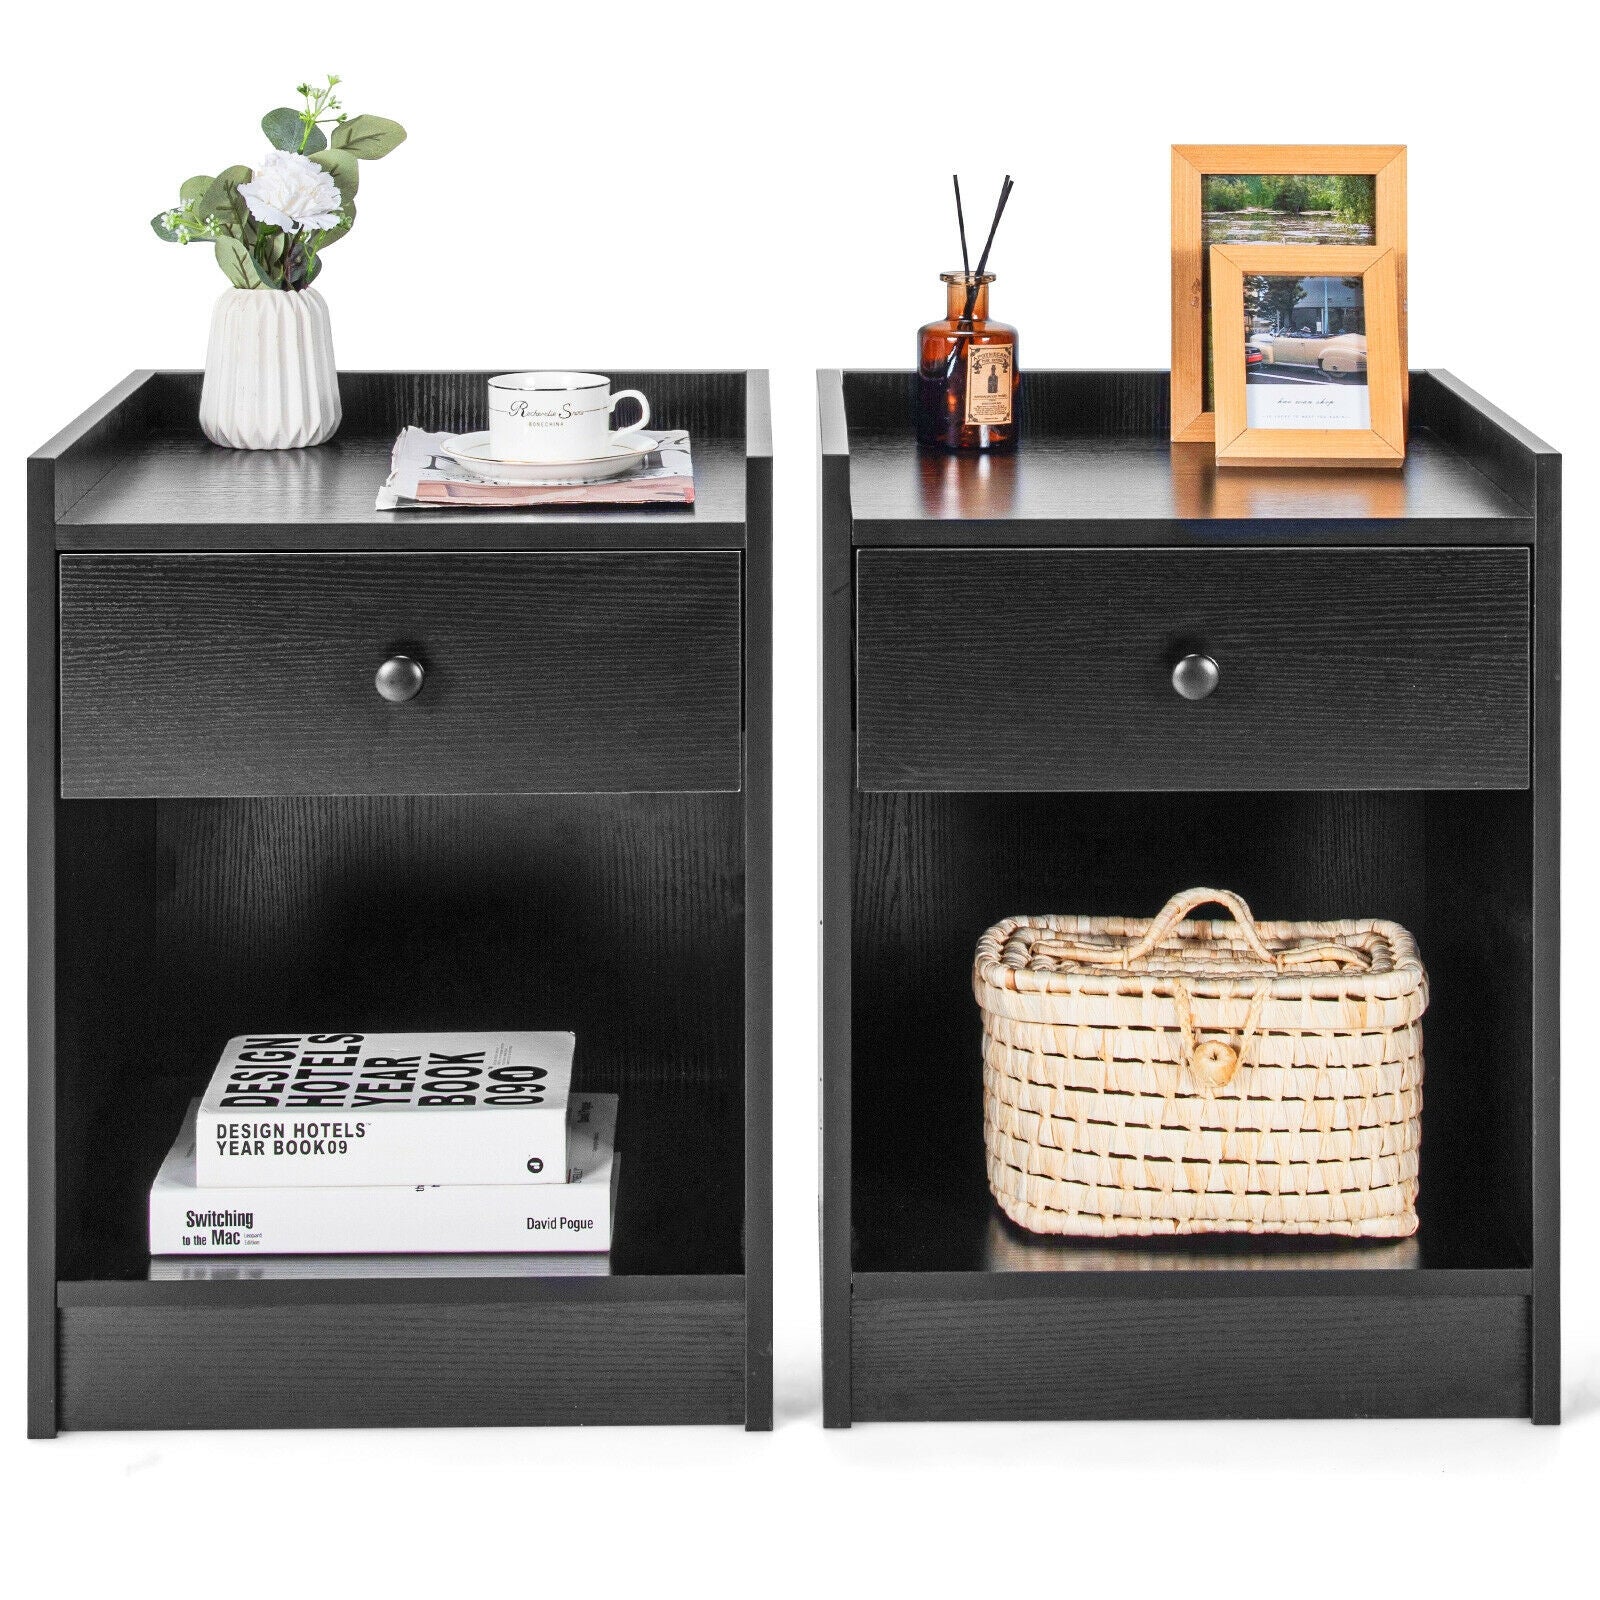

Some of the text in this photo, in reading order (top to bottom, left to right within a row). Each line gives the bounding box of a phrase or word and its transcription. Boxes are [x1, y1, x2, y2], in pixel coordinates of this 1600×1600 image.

[219, 1037, 302, 1108] DESIGN
[285, 1033, 365, 1108] HOTELS
[417, 1051, 486, 1107] BOOK
[350, 1055, 422, 1109] YEAR
[216, 1121, 366, 1140] DESIGN HOTELS
[216, 1140, 266, 1156] YEAR
[185, 1209, 254, 1230] Switching
[526, 1216, 594, 1233] David Pogue
[182, 1229, 241, 1246] to the Mac
